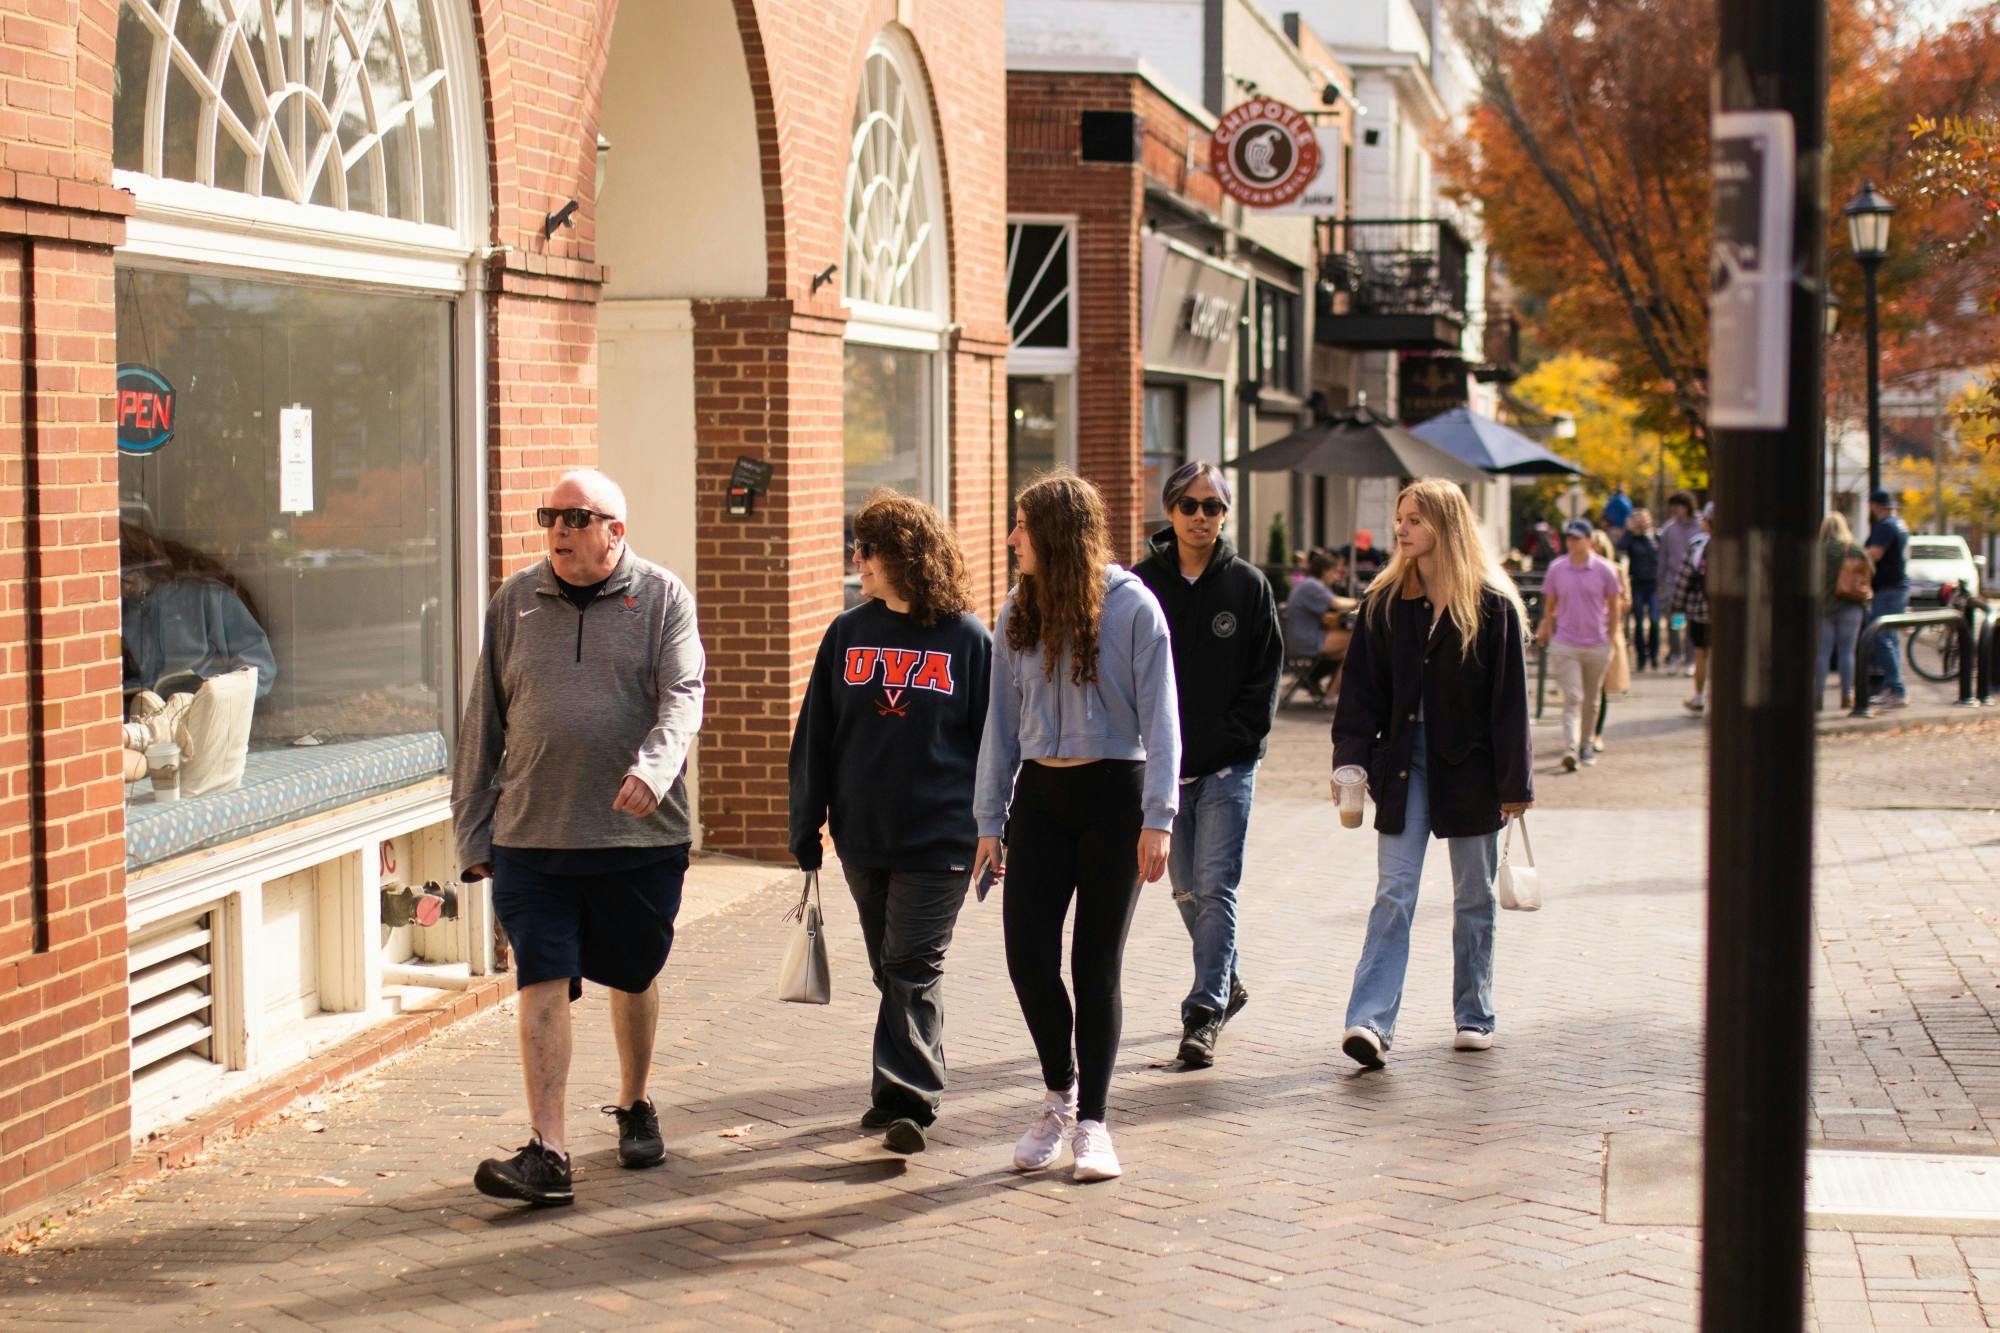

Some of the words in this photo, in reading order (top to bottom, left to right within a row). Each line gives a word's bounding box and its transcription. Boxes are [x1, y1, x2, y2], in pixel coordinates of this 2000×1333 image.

[1215, 101, 1313, 146] CHIPOTLE
[117, 390, 171, 430] PEN
[844, 647, 954, 695] UVA
